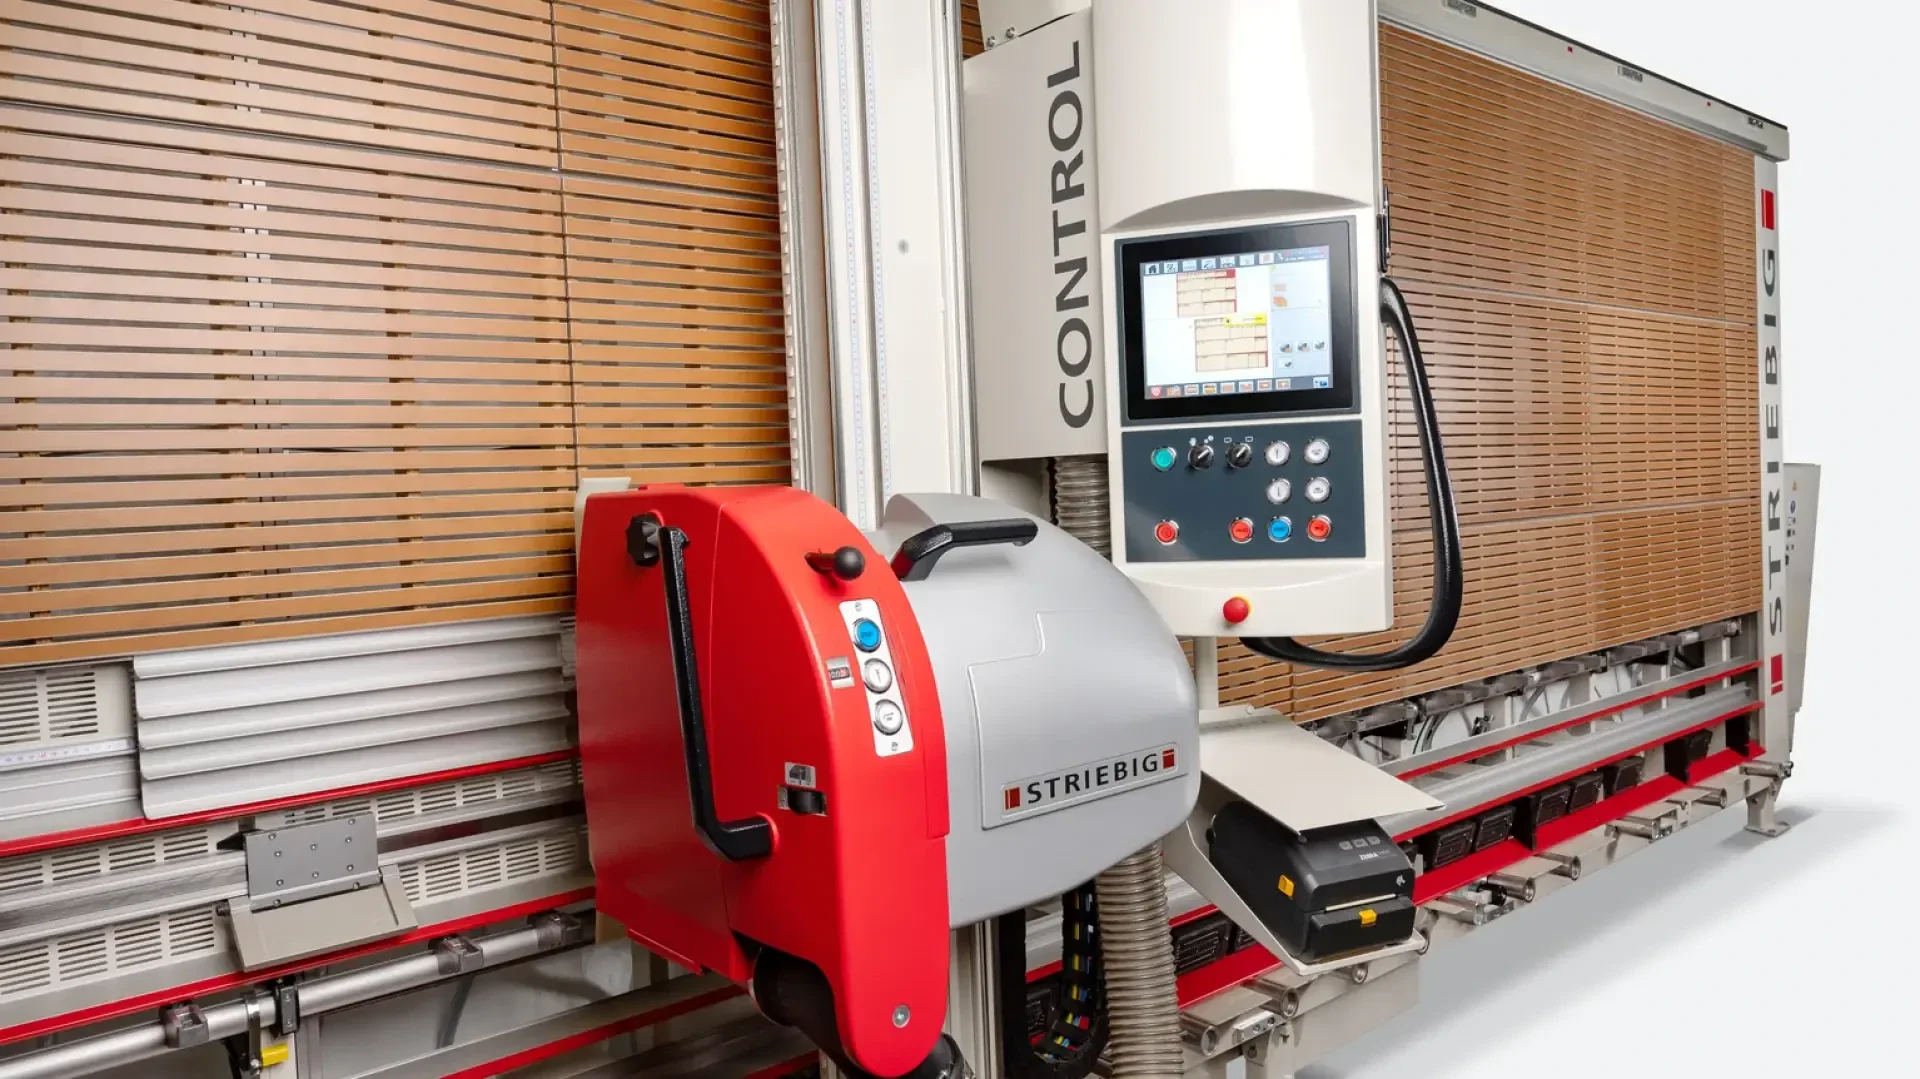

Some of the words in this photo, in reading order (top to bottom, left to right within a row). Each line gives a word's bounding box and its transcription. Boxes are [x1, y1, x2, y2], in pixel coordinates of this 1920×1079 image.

[1047, 40, 1094, 429] CONTROL
[1762, 249, 1783, 636] STRIEBIG
[1027, 753, 1158, 804] STRIEBIG
